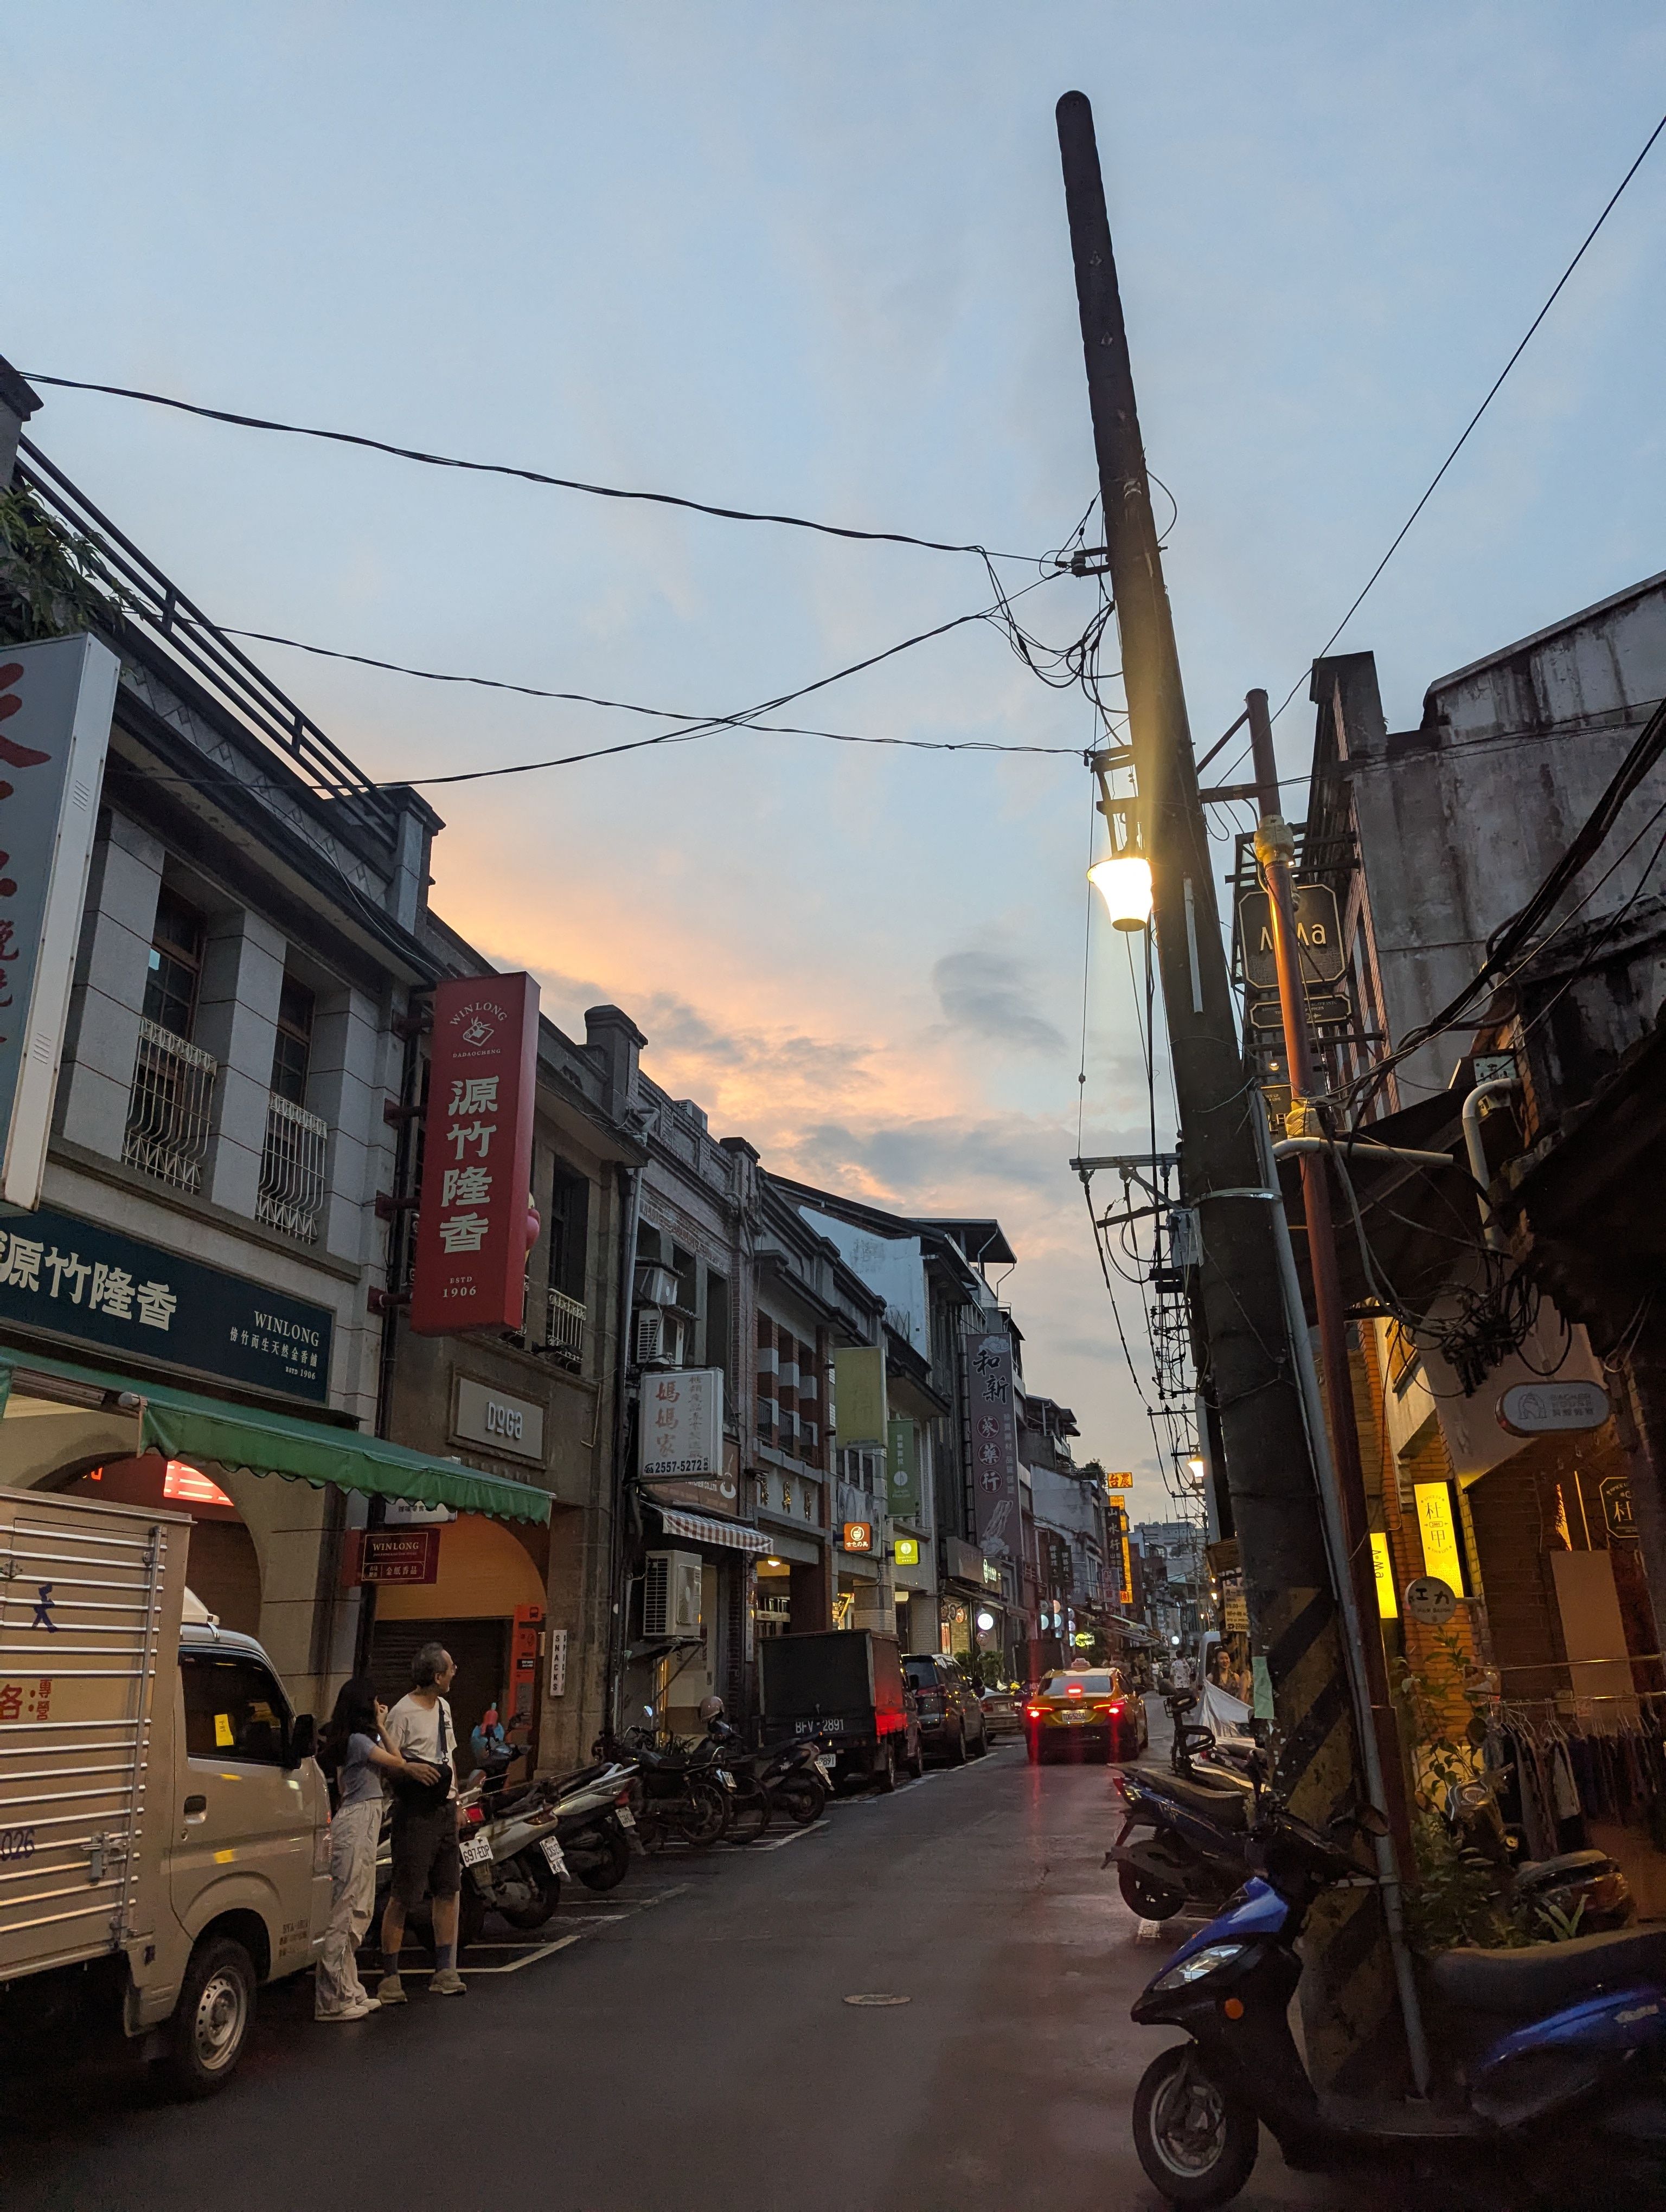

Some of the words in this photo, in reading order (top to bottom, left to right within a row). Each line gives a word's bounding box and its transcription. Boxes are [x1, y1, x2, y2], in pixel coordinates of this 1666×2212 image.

[450, 1002, 507, 1025] WINLONG
[453, 1049, 501, 1058] DADAOCHENG
[439, 1075, 499, 1253] 源竹隆香
[450, 1276, 473, 1284] ESTD
[443, 1285, 477, 1298] 1906
[254, 1310, 321, 1347] WINLONG
[300, 1368, 316, 1380] 1906
[972, 1349, 1009, 1404] 和新
[655, 1380, 681, 1458] 媽媽家
[655, 1460, 702, 1473] 2557-5272
[1107, 1508, 1120, 1551] 山水行
[373, 1542, 419, 1551] WINLONG
